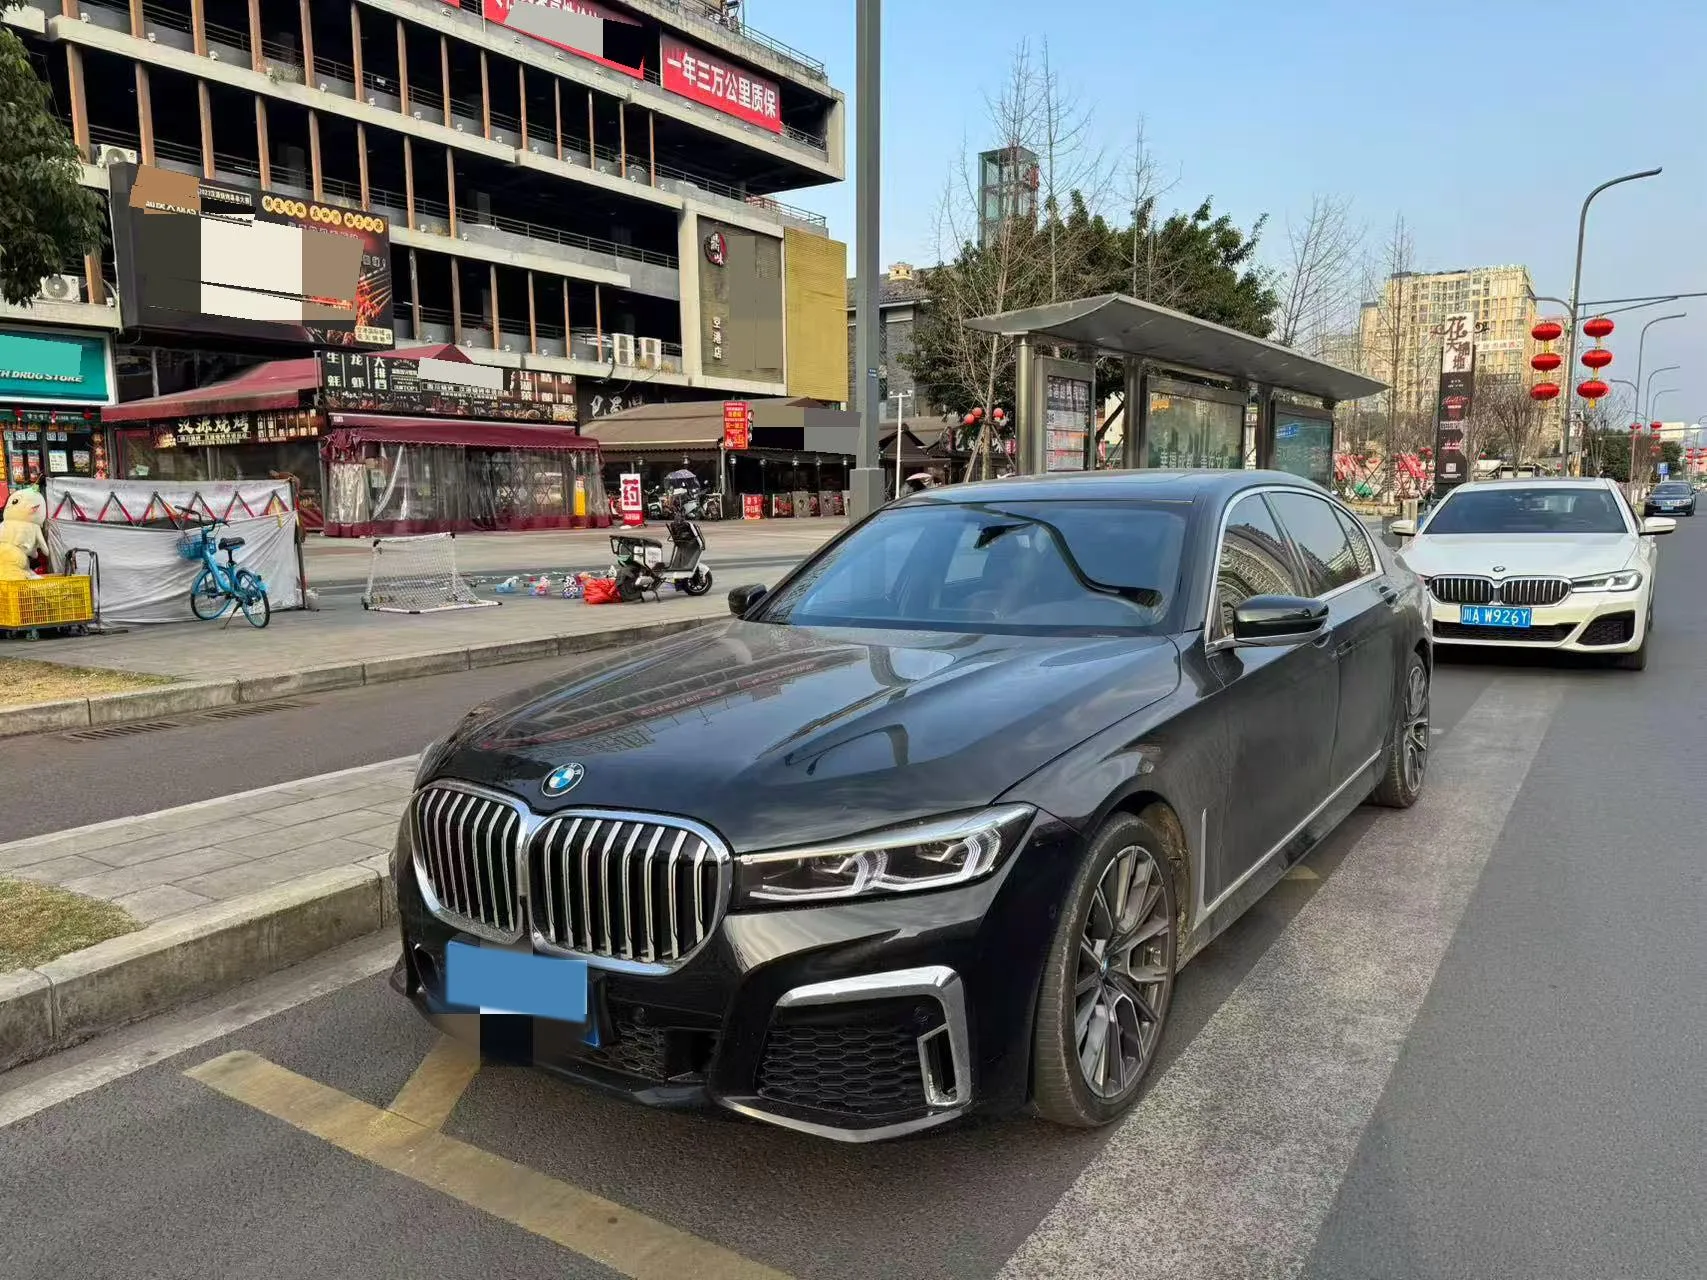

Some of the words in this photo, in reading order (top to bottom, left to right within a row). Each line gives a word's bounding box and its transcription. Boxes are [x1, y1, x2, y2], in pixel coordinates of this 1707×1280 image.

[667, 52, 776, 118] 一年三万公里质保
[12, 370, 44, 380] DRUG
